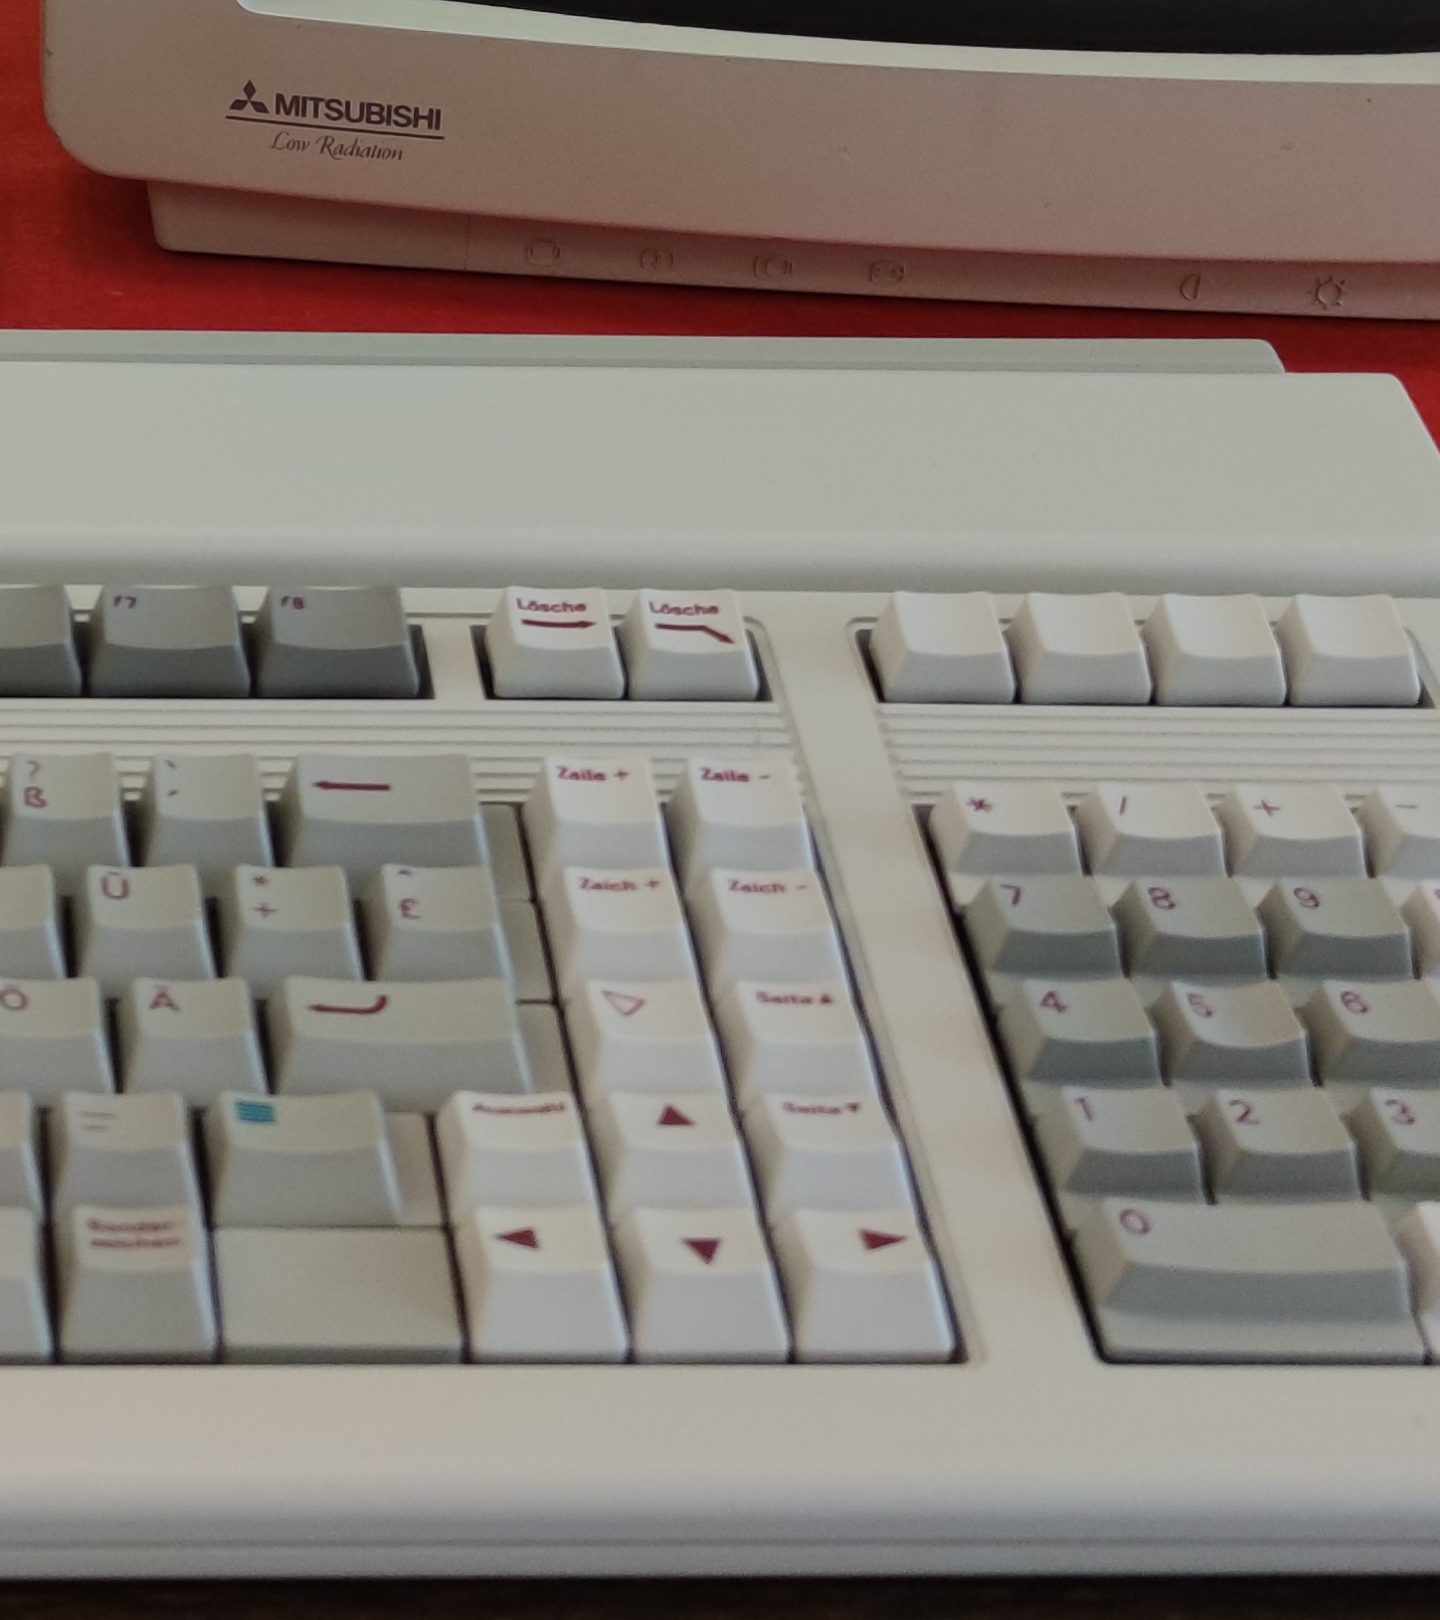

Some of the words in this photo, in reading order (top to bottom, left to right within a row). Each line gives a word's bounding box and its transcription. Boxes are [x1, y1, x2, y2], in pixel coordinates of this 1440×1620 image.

[275, 91, 442, 132] MITSUBISHI
[270, 131, 311, 153] Low
[315, 134, 404, 161] Radiation
[517, 598, 587, 614] Lösche
[649, 600, 720, 617] Lösche
